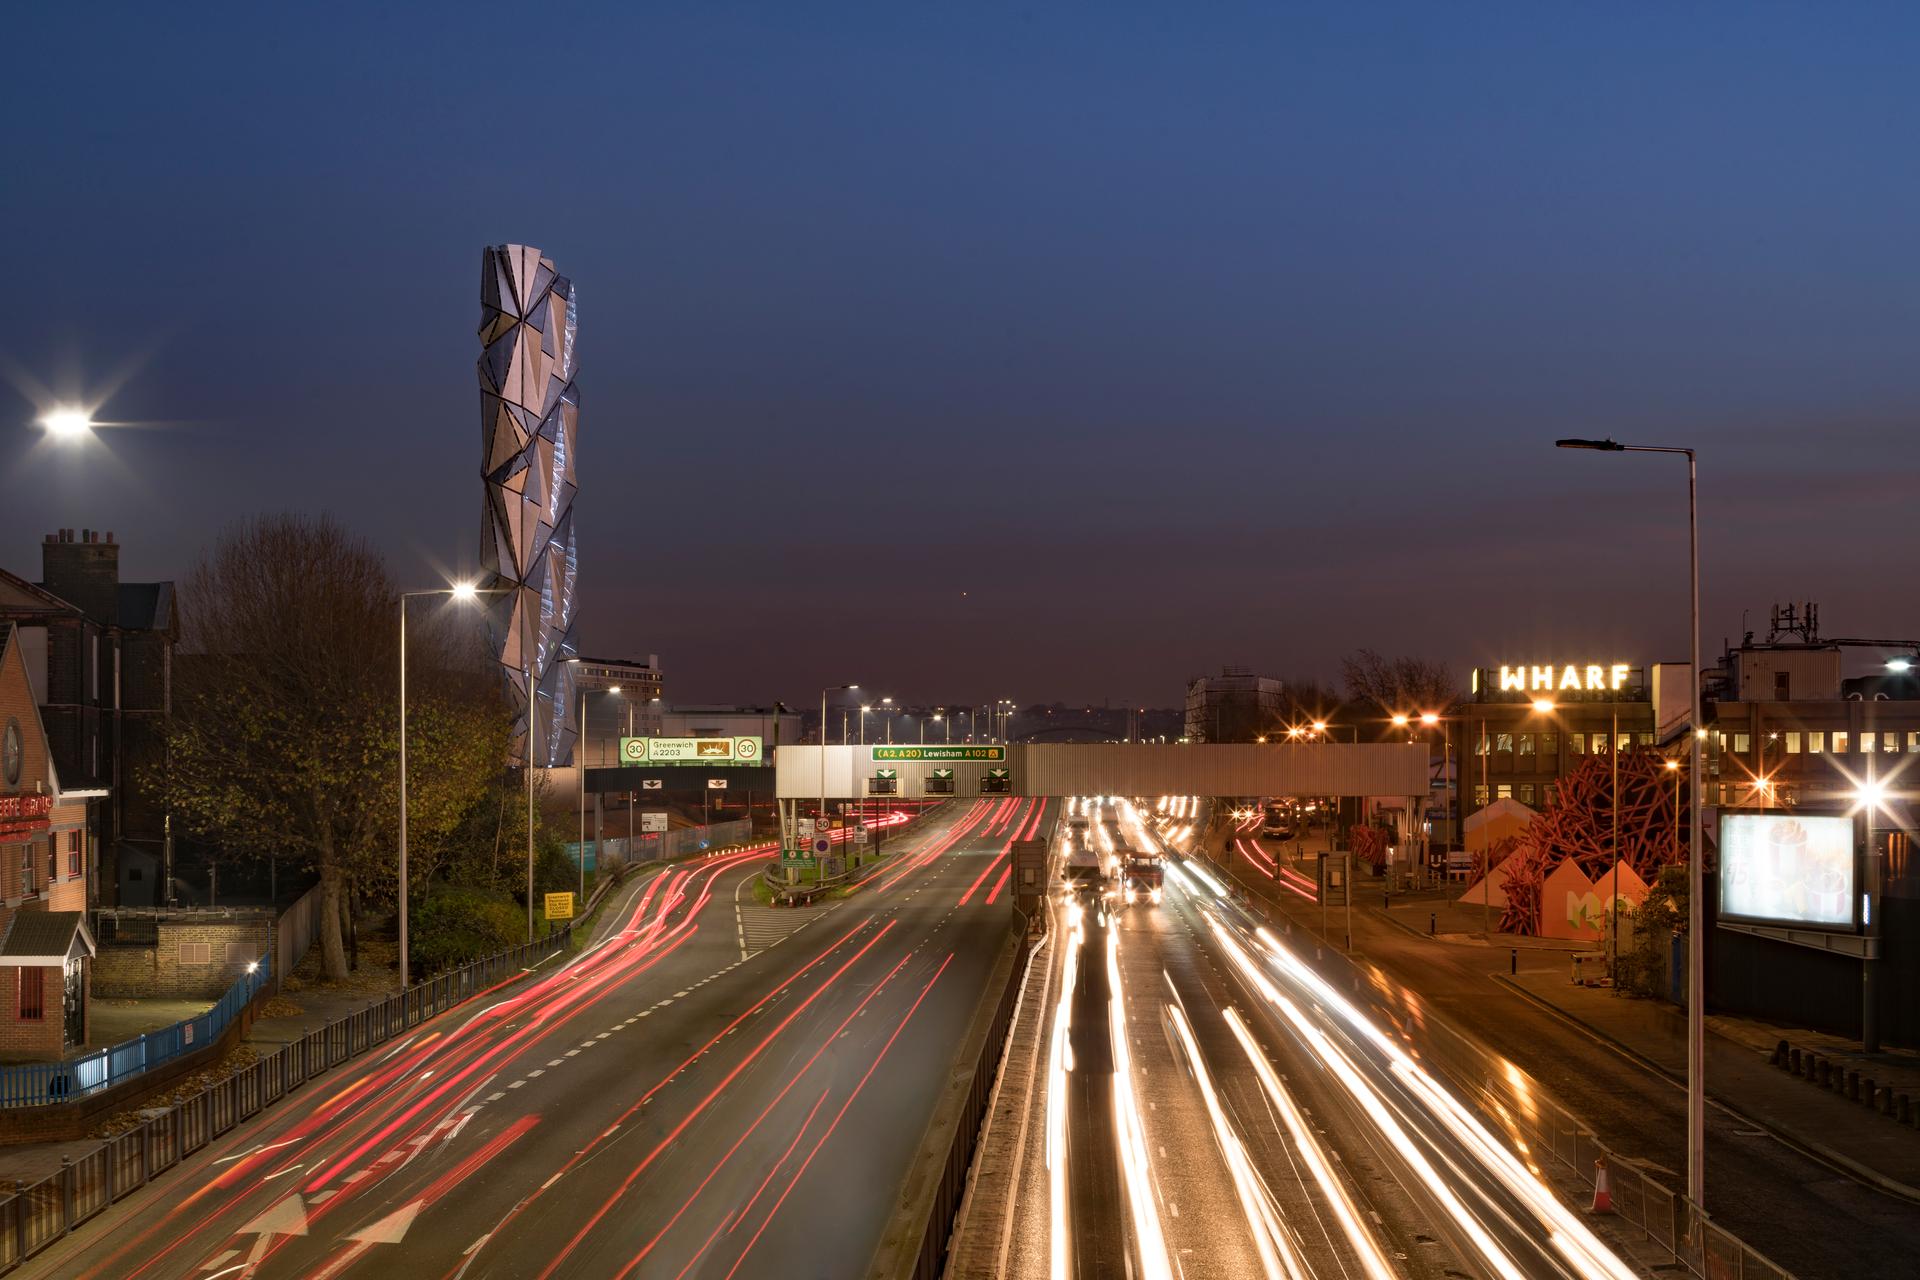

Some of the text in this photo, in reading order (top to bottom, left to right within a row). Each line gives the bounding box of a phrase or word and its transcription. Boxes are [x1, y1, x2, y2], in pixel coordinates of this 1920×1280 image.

[1501, 665, 1629, 691] WHARF
[629, 745, 643, 754] 30
[653, 741, 693, 749] Greenwich
[740, 744, 754, 753] 30
